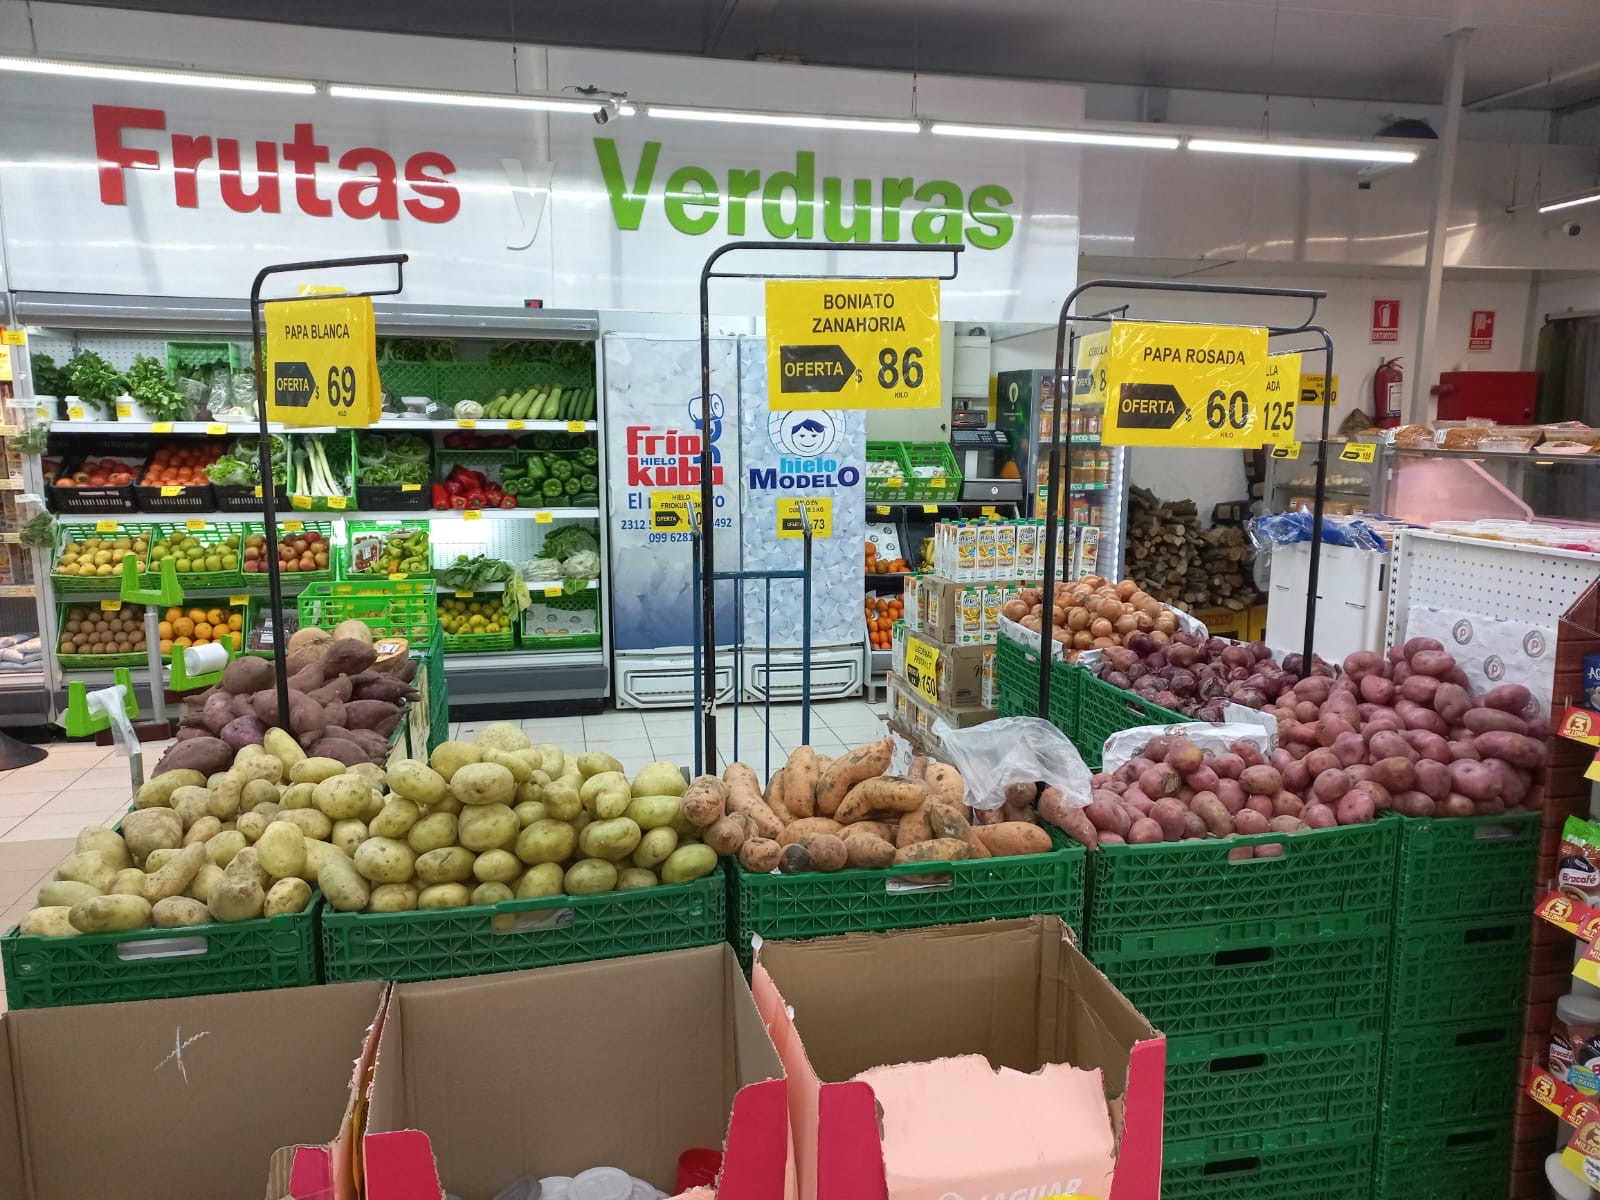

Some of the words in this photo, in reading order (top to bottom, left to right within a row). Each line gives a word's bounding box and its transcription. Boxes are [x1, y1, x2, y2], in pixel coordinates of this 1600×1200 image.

[93, 104, 462, 224] Frutas
[500, 157, 556, 250] y
[593, 137, 1015, 250] Verduras
[824, 293, 895, 310] BONIATO
[285, 325, 309, 340] PAPA
[311, 324, 350, 339] BLANCA
[812, 316, 906, 333] ZANAHORIA
[1143, 347, 1181, 363] PAPA
[1186, 349, 1246, 365] ROSADA
[784, 361, 844, 376] OFERTA
[855, 369, 862, 383] $
[877, 346, 924, 389] 86
[276, 378, 309, 391] OFERTA
[315, 385, 320, 400] $
[327, 365, 356, 407] 69
[894, 391, 908, 399] KILO
[1122, 398, 1175, 414] OFERTA
[1185, 407, 1192, 422] $
[1206, 389, 1249, 430] 60
[1263, 401, 1295, 431] 125
[626, 426, 701, 455] Frío
[640, 457, 676, 466] HIELO
[780, 457, 837, 474] hielo
[628, 492, 642, 509] El
[621, 519, 646, 530] 2312
[813, 519, 825, 530] 73
[649, 533, 668, 543] 099
[921, 674, 936, 697] 150
[1563, 872, 1597, 884] Bracafé
